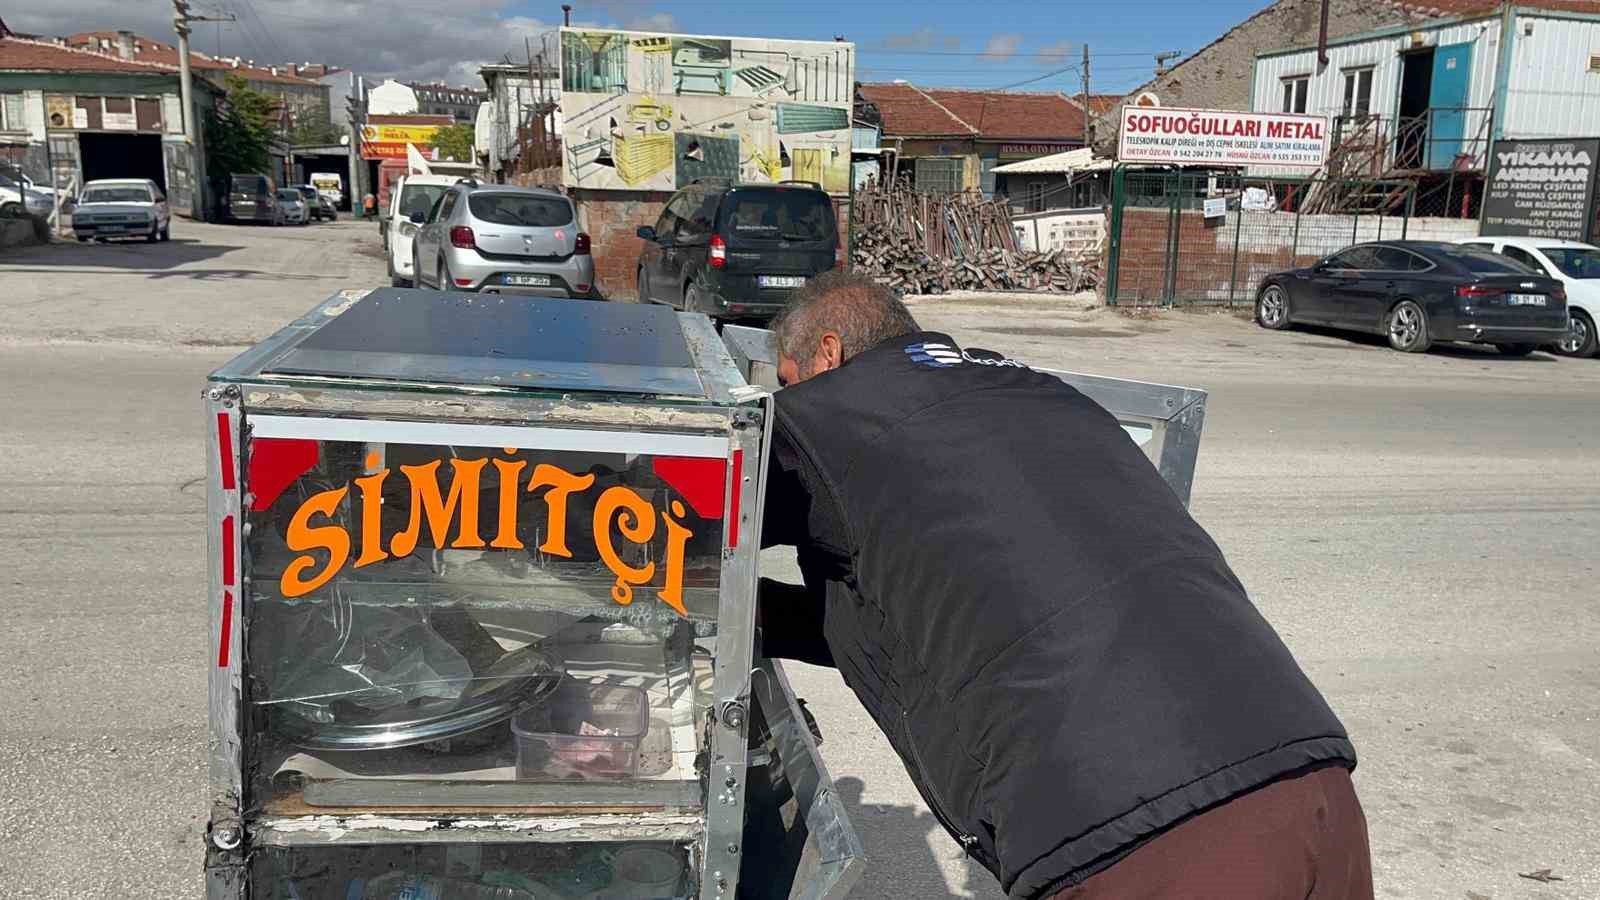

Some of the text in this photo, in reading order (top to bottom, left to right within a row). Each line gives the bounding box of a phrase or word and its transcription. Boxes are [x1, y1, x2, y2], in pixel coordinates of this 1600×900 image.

[1127, 112, 1323, 139] SOFUOĞULLARI METAL
[1161, 137, 1177, 145] KALIP
[1216, 139, 1233, 148] CEPHE
[1149, 147, 1170, 156] ÖZCAN
[1497, 151, 1592, 166] YIKAMA
[1495, 167, 1589, 182] AKSESUAR
[1492, 181, 1586, 192] LED XENON ÇEŞİTLERİ
[1516, 191, 1545, 199] PASPAS
[1547, 191, 1586, 201] ÇEŞİTLERİ
[1514, 200, 1533, 208] CAM
[1551, 210, 1583, 218] KAPAĞI
[1546, 218, 1582, 229] ÇEŞİTLERİ
[280, 447, 693, 617] SİMİTÇİ
